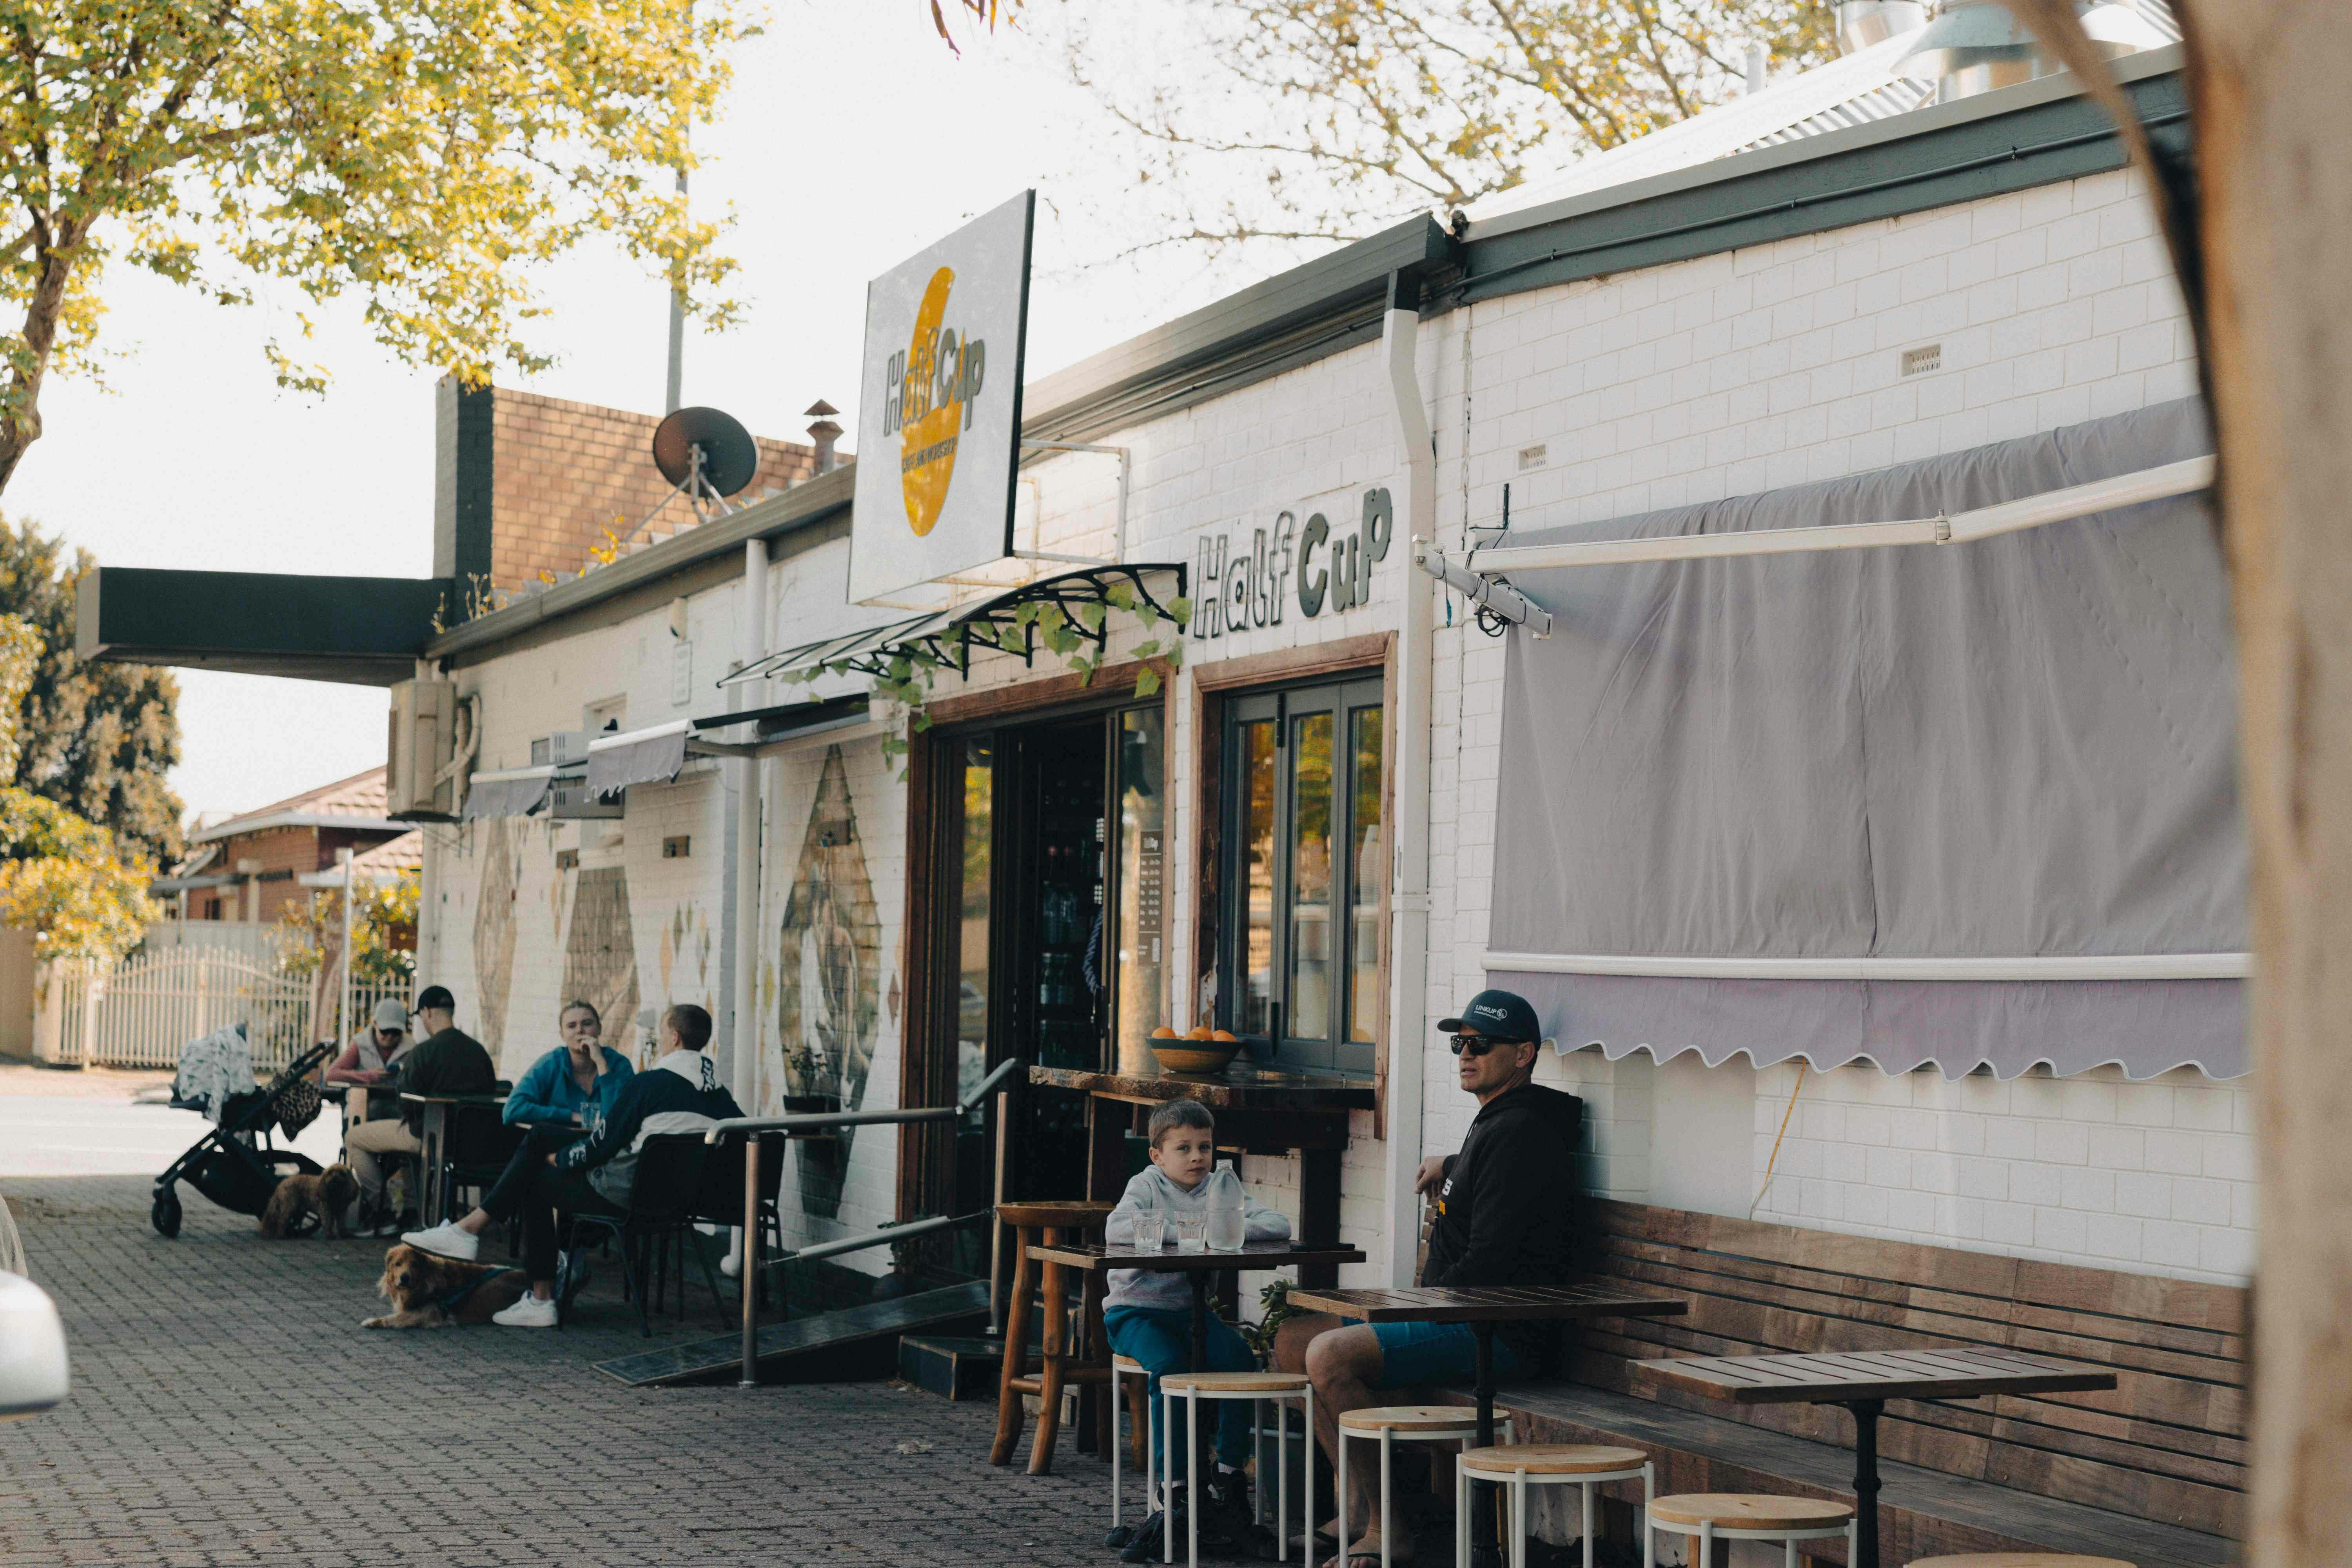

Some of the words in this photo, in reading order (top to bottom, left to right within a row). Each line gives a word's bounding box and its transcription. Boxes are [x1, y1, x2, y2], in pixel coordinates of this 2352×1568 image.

[884, 327, 939, 437] Half
[936, 328, 985, 432] Cup
[1194, 511, 1294, 639] Half
[1298, 487, 1392, 618] Cup
[1475, 1004, 1497, 1014] LINKUP
